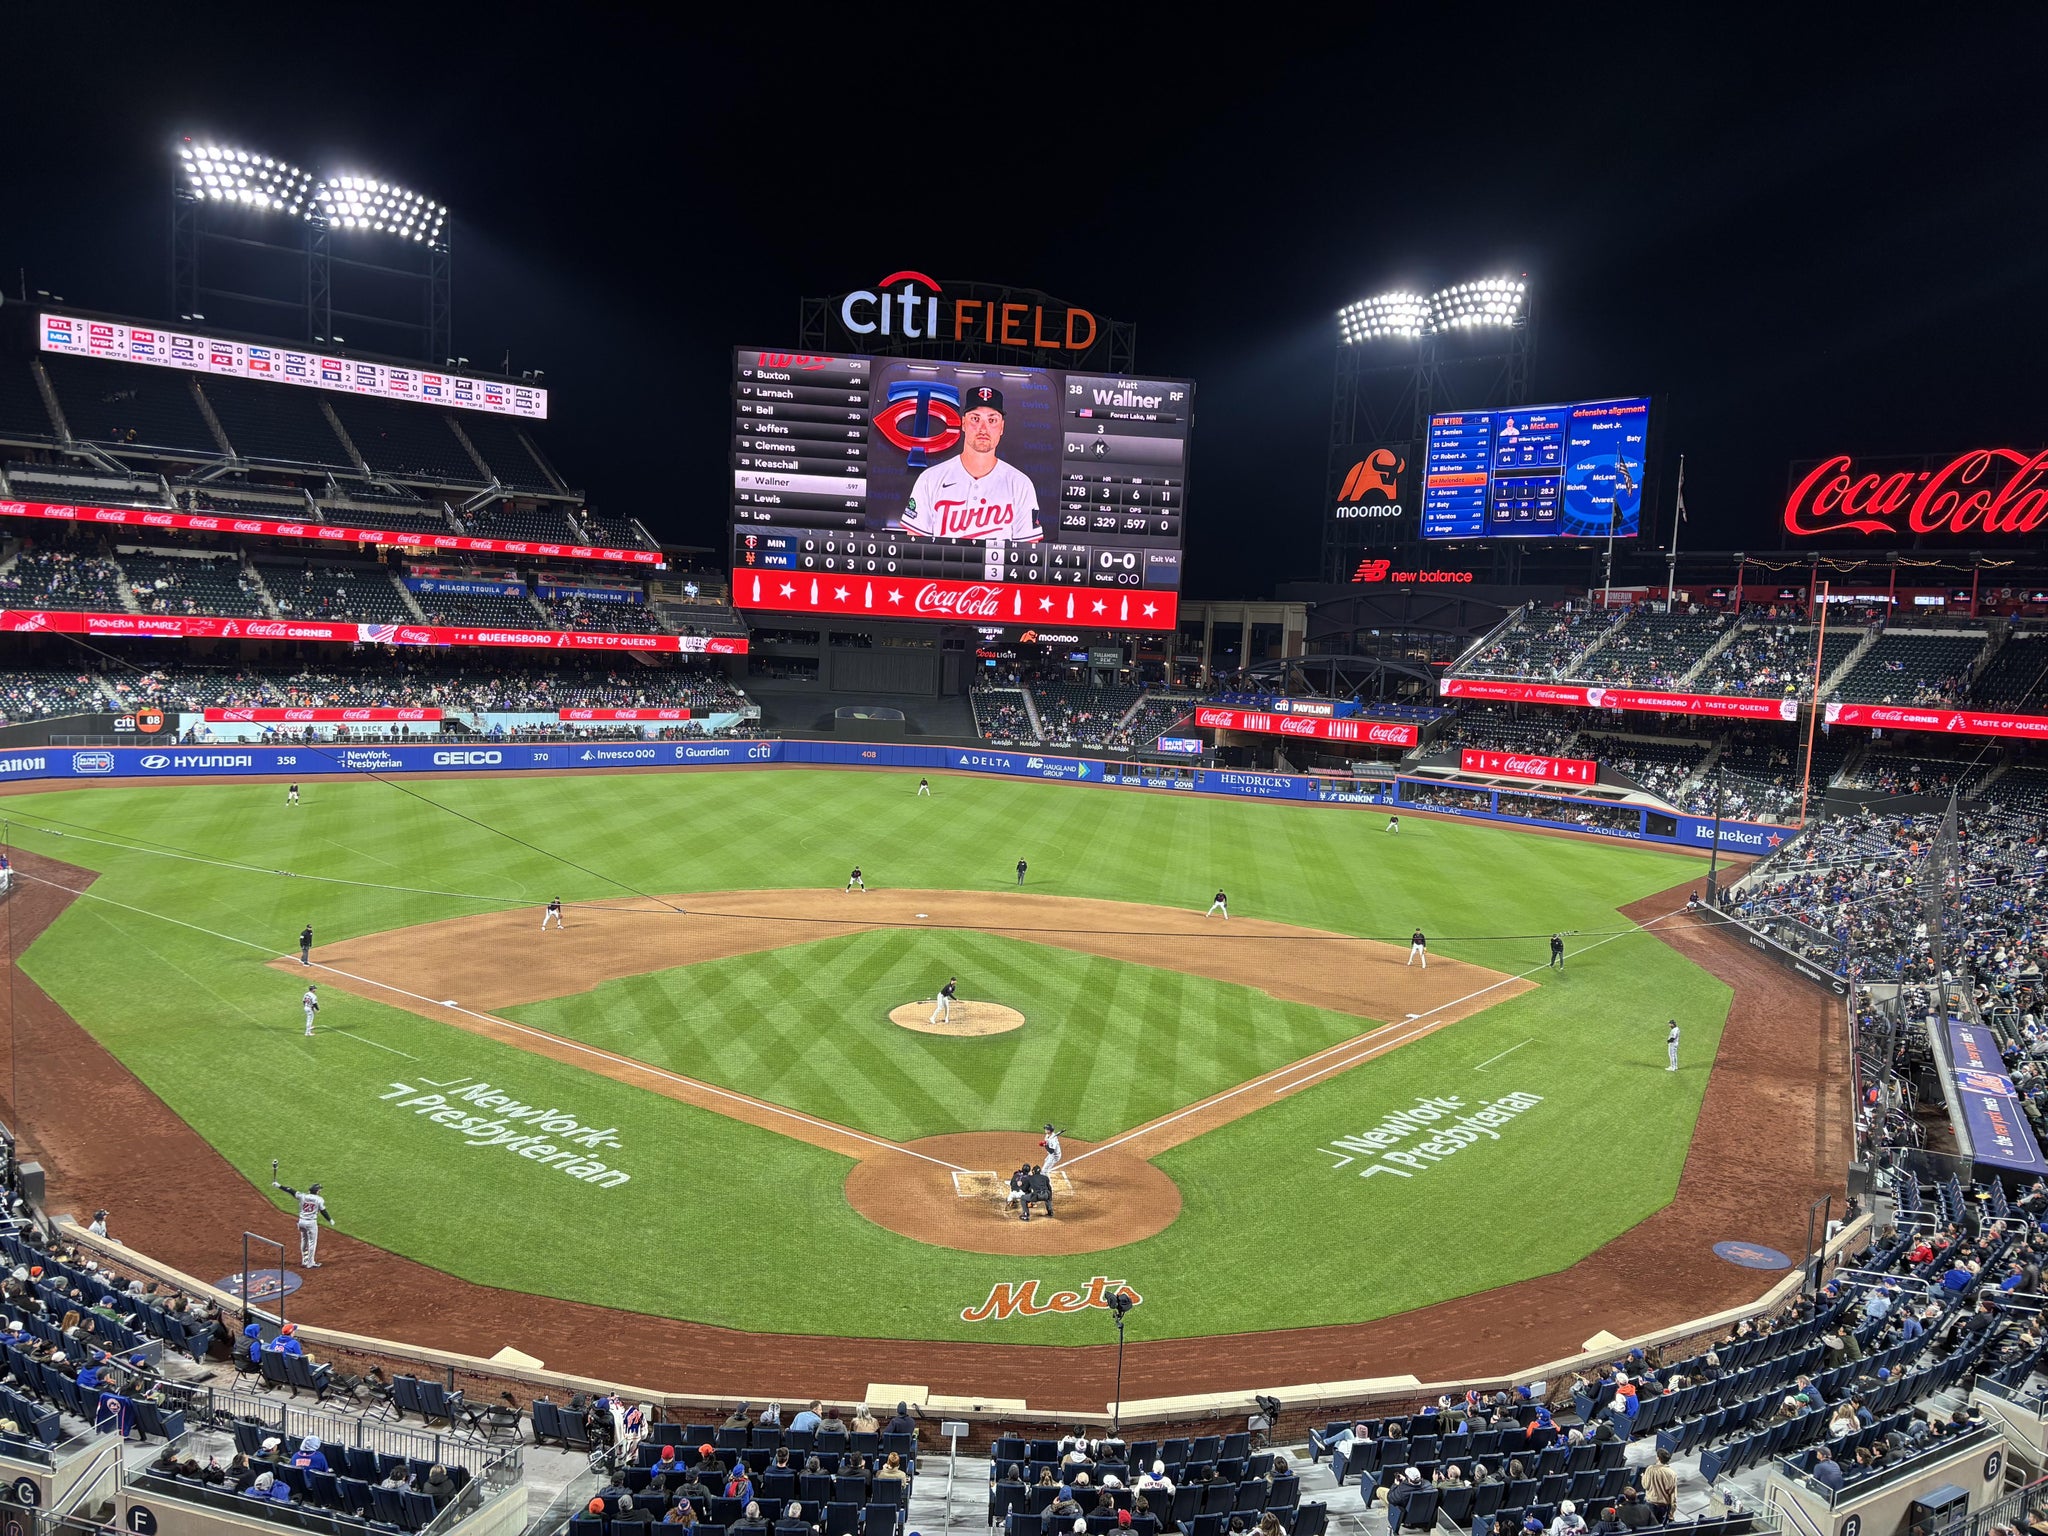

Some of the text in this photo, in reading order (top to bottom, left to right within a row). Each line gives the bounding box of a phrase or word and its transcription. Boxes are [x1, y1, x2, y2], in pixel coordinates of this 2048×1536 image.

[841, 283, 1097, 350] citi FIELD
[50, 320, 70, 329] STL
[49, 332, 70, 342] MIA
[92, 327, 113, 336] ATL
[134, 332, 153, 341] PHI
[91, 339, 113, 348] WSH
[132, 344, 154, 353] CHC
[172, 350, 193, 359] COL
[286, 355, 306, 364] HOU
[391, 370, 409, 380] NYY
[424, 376, 441, 385] BAL
[757, 371, 790, 381] Buxton
[456, 381, 471, 389] PIT
[456, 391, 472, 399] TEX
[757, 388, 793, 399] Larnach
[1069, 381, 1184, 409] 38 Matt Wallner RF
[756, 406, 774, 415] Bell
[1573, 405, 1646, 418] defensive alignment
[1130, 413, 1145, 421] Lake,
[756, 424, 789, 434] Jeffers
[1530, 422, 1558, 430] McLean
[1571, 439, 1590, 447] Benge
[1626, 435, 1642, 443] Baty
[755, 441, 796, 453] Clemens
[1068, 443, 1104, 454] 0-1 K
[755, 459, 798, 470] Keaschall
[755, 476, 790, 487] Wallner
[1066, 486, 1086, 496] .178
[1784, 448, 2048, 535] Coca-Cola
[754, 494, 781, 504] Lewis
[754, 512, 771, 521] Lee
[1336, 504, 1402, 518] moomoo
[934, 498, 1014, 536] Twins
[1063, 515, 1146, 529] .268 .329 .597
[1435, 525, 1452, 533] Benge
[767, 540, 786, 548] MIN
[765, 555, 787, 565] NYM
[1100, 551, 1136, 569] 0-0
[1095, 574, 1114, 582] Outs:
[1391, 569, 1473, 583] new balance
[439, 584, 470, 592] MILAGRO
[472, 585, 500, 593] TEQUILA
[915, 583, 1004, 615] Coca-Cola
[88, 618, 182, 630] TAQUERIA RAMIREZ
[246, 622, 332, 638] Coca-Cola CORNER
[478, 633, 551, 644] QUEENSBORO
[575, 635, 657, 647] TASTE OF QUEENS
[1039, 634, 1079, 643] moomoo
[975, 648, 997, 658] Coors
[1274, 701, 1331, 715] citi PAVILION
[1637, 698, 1688, 707] QUEENSBORO
[1705, 701, 1726, 709] TASTE
[1739, 703, 1770, 712] QUEENS
[114, 716, 160, 727] citi 08
[1200, 710, 1234, 727] Coca-Cola
[1871, 710, 1939, 724] Coca-Cola CORNER
[1280, 717, 1318, 735] Coca-Cola
[1972, 719, 1999, 728] TASTE
[2000, 720, 2014, 728] OF
[1369, 725, 1410, 743] Coca-Cola
[348, 751, 390, 760] NewYork-
[534, 753, 549, 761] 370
[597, 749, 655, 759] Invesco QQQ
[686, 746, 730, 757] Guardian
[748, 745, 771, 759] citi
[174, 756, 252, 767] HYUNDAI
[277, 756, 296, 765] 358
[433, 751, 502, 764] GEICO
[972, 756, 1010, 768] DELTA
[0, 757, 46, 772] anon
[348, 759, 402, 769] Presbyterian
[1043, 763, 1077, 773] HAUGLAND
[1503, 757, 1550, 776] Coca-Cola
[1043, 769, 1064, 777] GROUP
[1102, 774, 1116, 783] 380
[1174, 781, 1193, 789] GOYA
[1220, 774, 1291, 788] HENDRICK'S
[1338, 793, 1374, 804] DUNKIN'
[1415, 804, 1462, 815] CADILLAC
[1586, 826, 1641, 839] CADILLAC
[1696, 825, 1763, 845] Heneken
[447, 1083, 623, 1148] NewYork-
[1330, 1095, 1466, 1155] NewYork-
[1982, 1097, 2014, 1147] the new york mets
[1381, 1091, 1544, 1170] Presbyterian
[395, 1094, 631, 1189] Presbyterian
[303, 1203, 316, 1212] 23
[960, 1276, 1143, 1321] Mets
[1988, 1456, 1998, 1475] B
[18, 1483, 34, 1504] G
[135, 1511, 148, 1531] F
[1846, 1520, 1856, 1536] B
